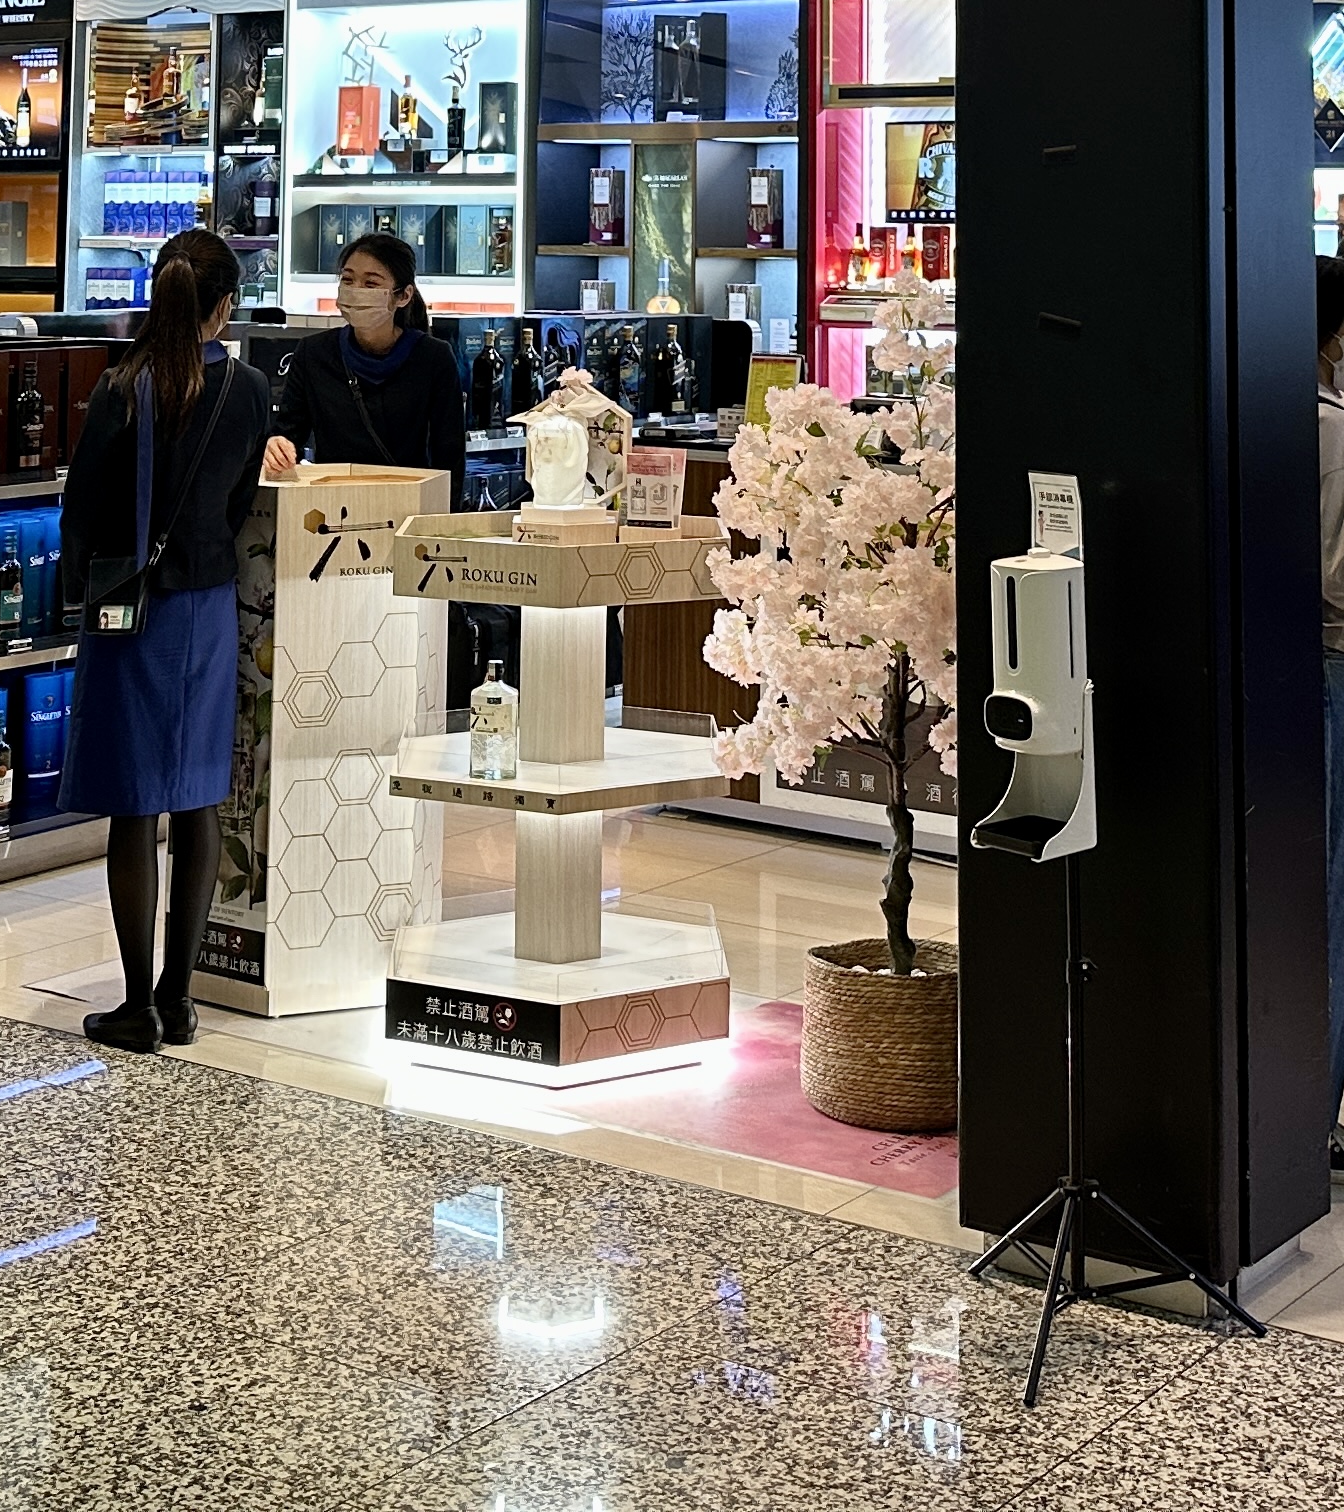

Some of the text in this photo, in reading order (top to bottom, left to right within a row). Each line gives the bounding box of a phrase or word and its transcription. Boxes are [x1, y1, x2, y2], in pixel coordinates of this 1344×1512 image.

[926, 142, 956, 158] CHIVA
[340, 565, 394, 577] ROKU GIN
[461, 568, 538, 587] ROKU GIN
[425, 996, 490, 1024] 禁止酒駕
[397, 1020, 542, 1060] 未滿十八歲禁止飲酒
